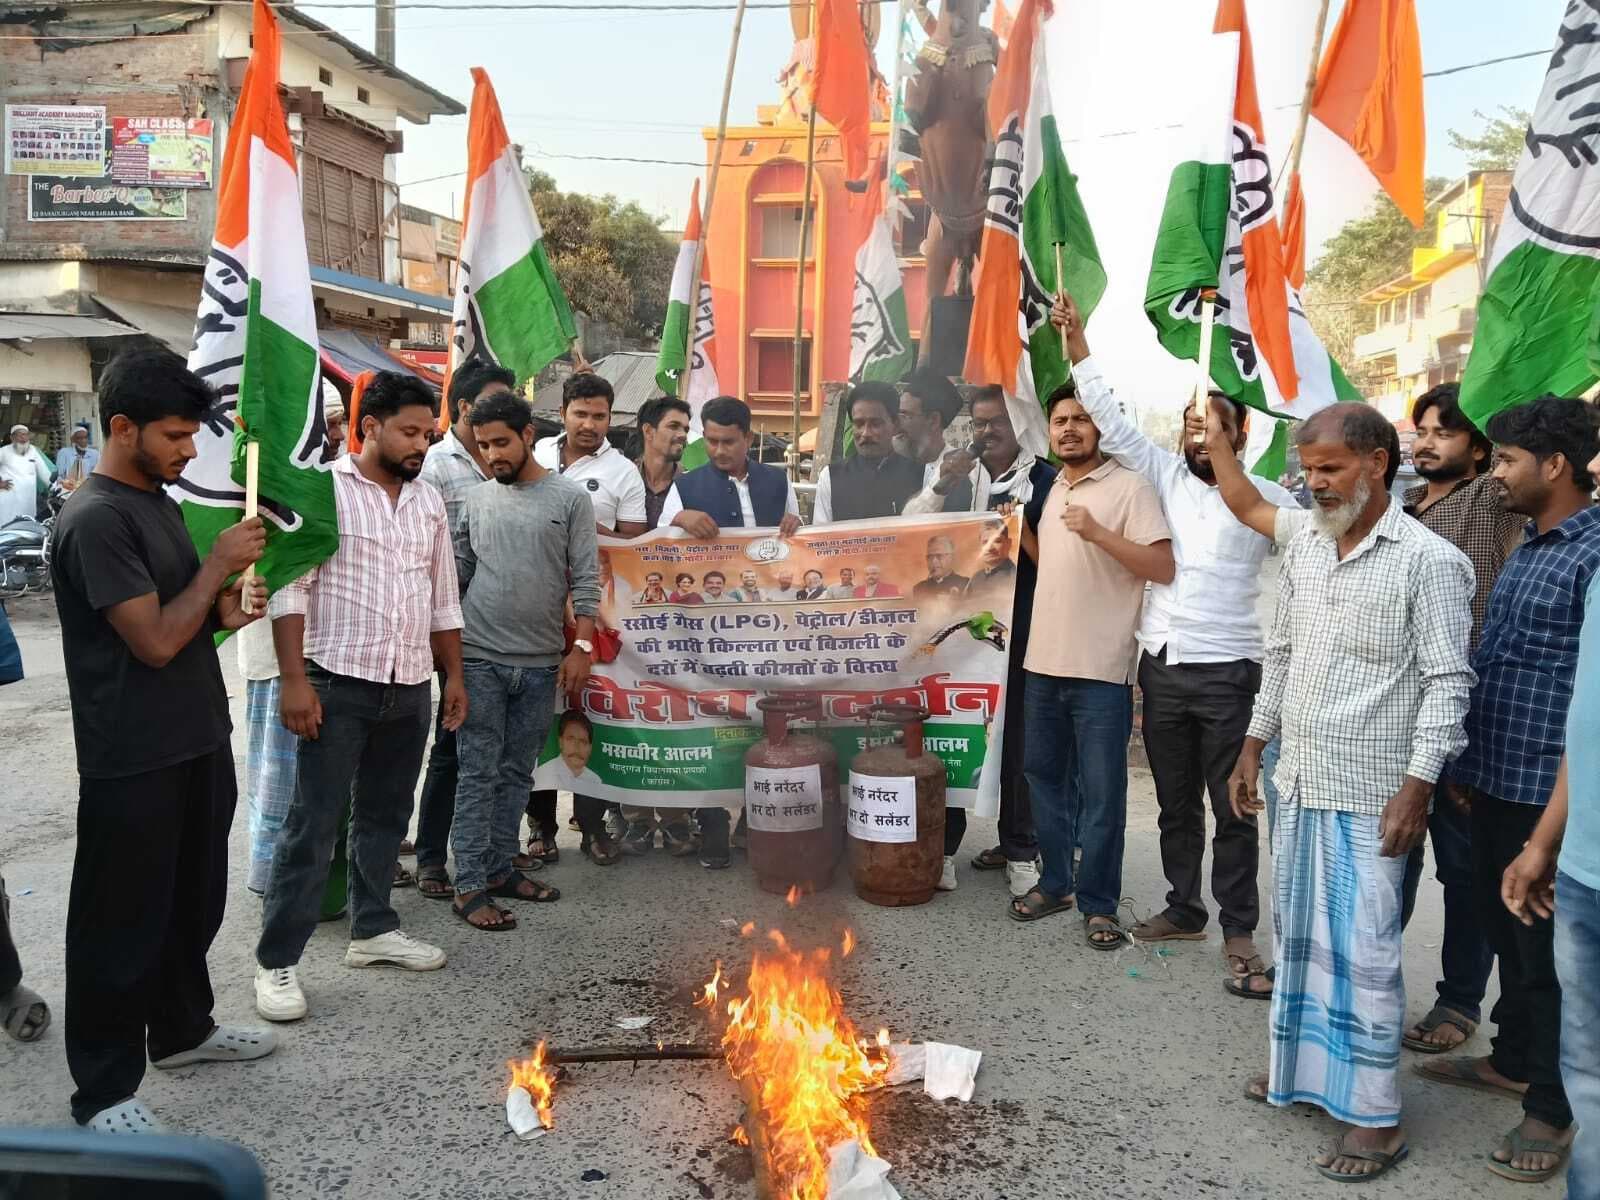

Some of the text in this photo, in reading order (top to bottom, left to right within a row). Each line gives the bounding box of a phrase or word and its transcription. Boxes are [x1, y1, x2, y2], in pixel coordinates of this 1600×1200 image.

[150, 118, 195, 129] CLASSS
[34, 183, 49, 191] THE
[622, 612, 669, 631] रसोई
[673, 612, 704, 630] गैस
[710, 613, 788, 633] (LPG),
[635, 637, 662, 653] की
[667, 637, 704, 653] भारी
[707, 637, 779, 653] किल्लत
[783, 635, 814, 651] एवं
[884, 631, 907, 648] के
[646, 659, 679, 675] दरों
[680, 658, 698, 674] में
[752, 659, 818, 676] कीमतों
[820, 658, 840, 674] के
[664, 745, 713, 761] आलम
[753, 779, 771, 794] भाई
[852, 785, 865, 801] भाई
[751, 802, 763, 816] भर
[765, 803, 777, 817] दो
[859, 808, 869, 824] दो
[874, 811, 911, 827] सलेंडर
